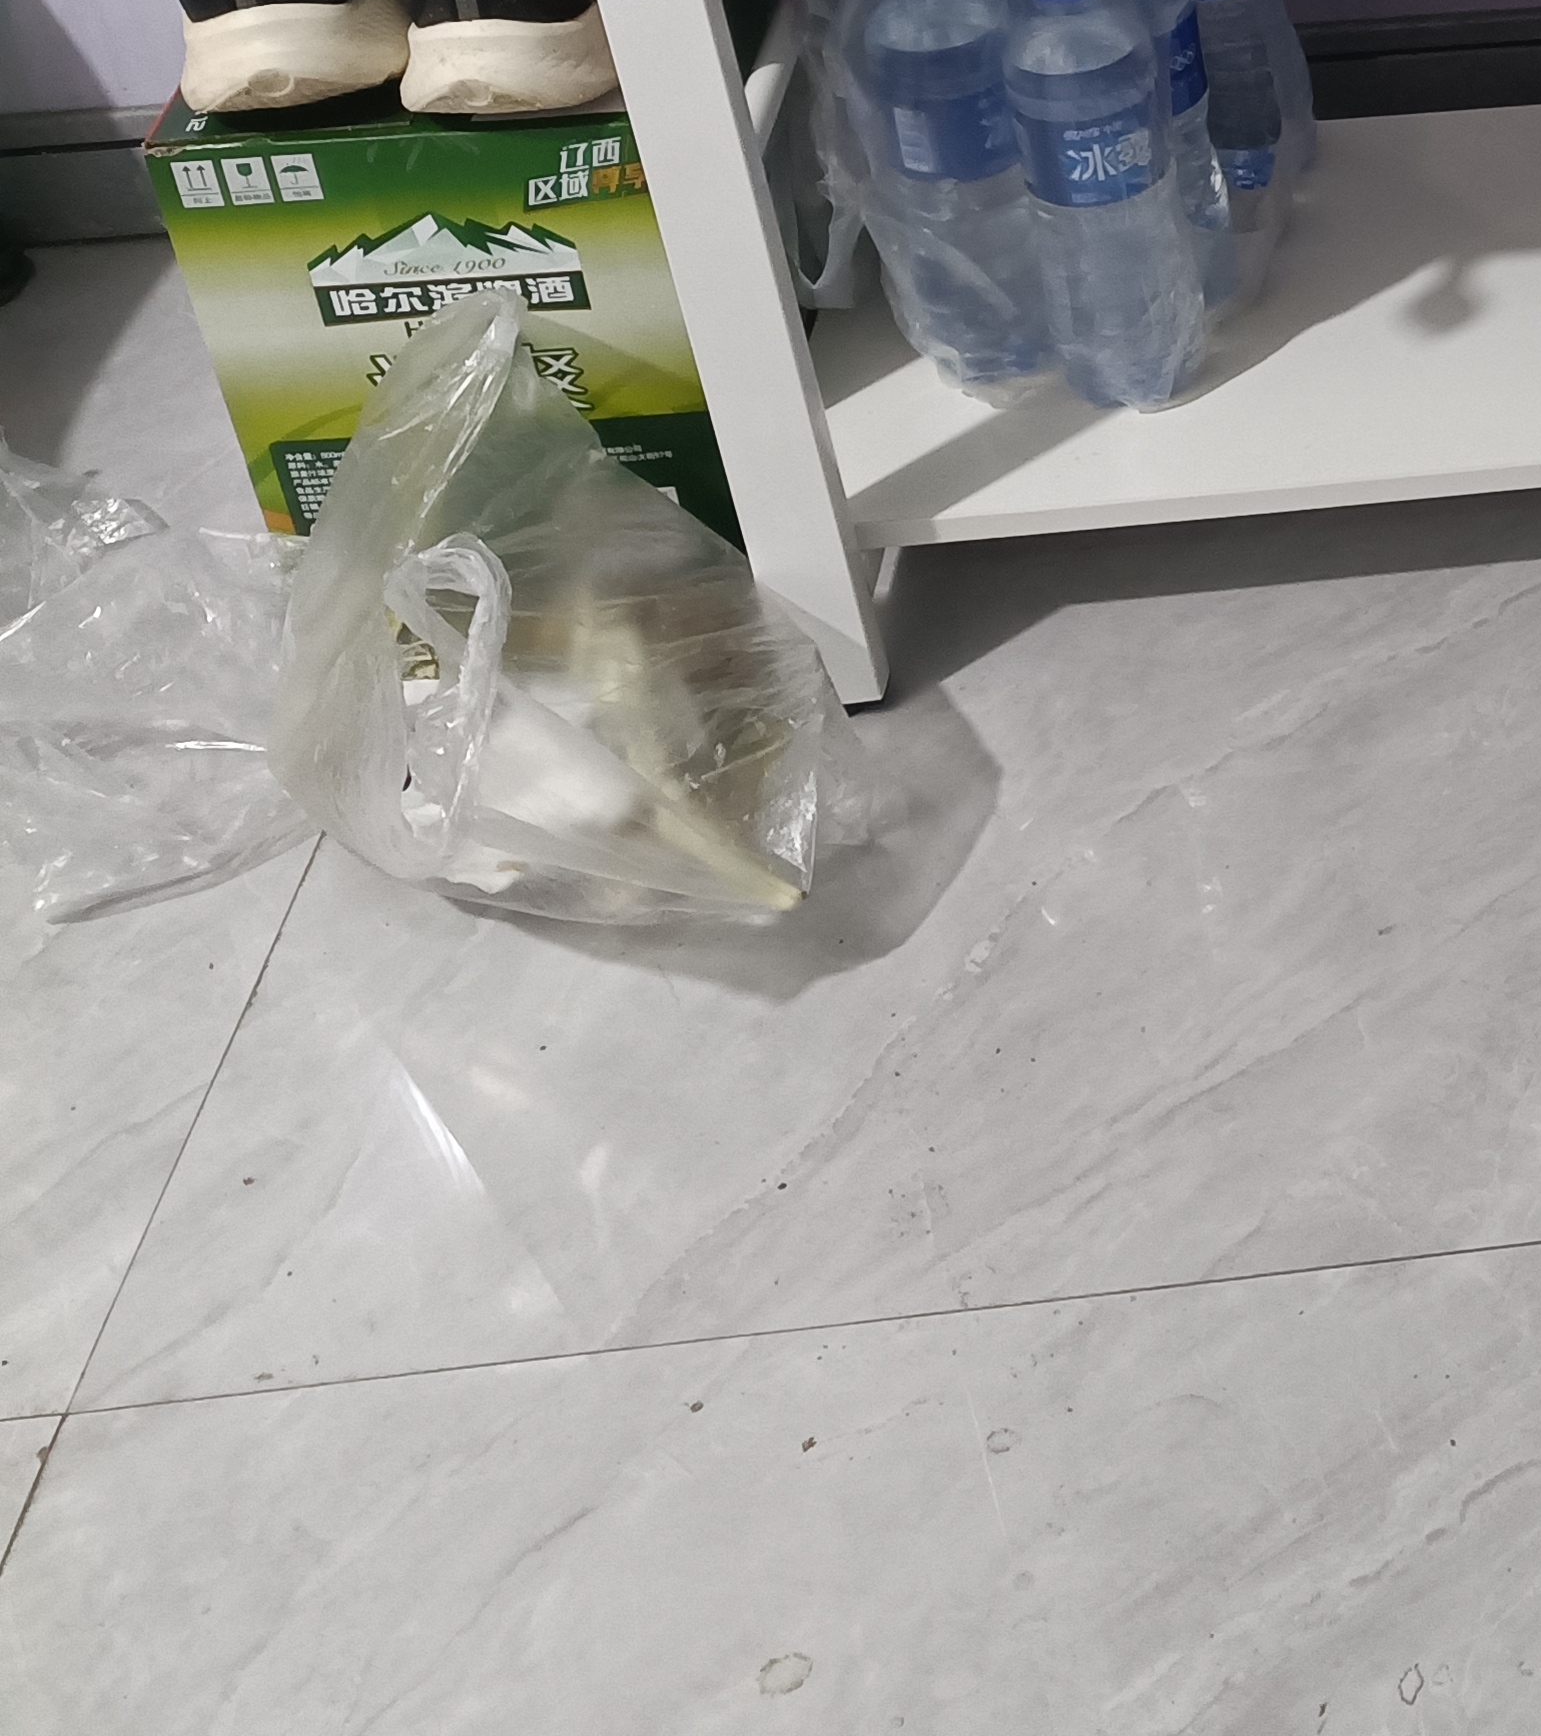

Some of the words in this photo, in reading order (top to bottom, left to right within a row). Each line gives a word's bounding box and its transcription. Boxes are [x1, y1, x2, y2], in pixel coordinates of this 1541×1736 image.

[560, 136, 622, 173] 辽西
[383, 261, 444, 277] Since
[452, 257, 507, 276] 1900
